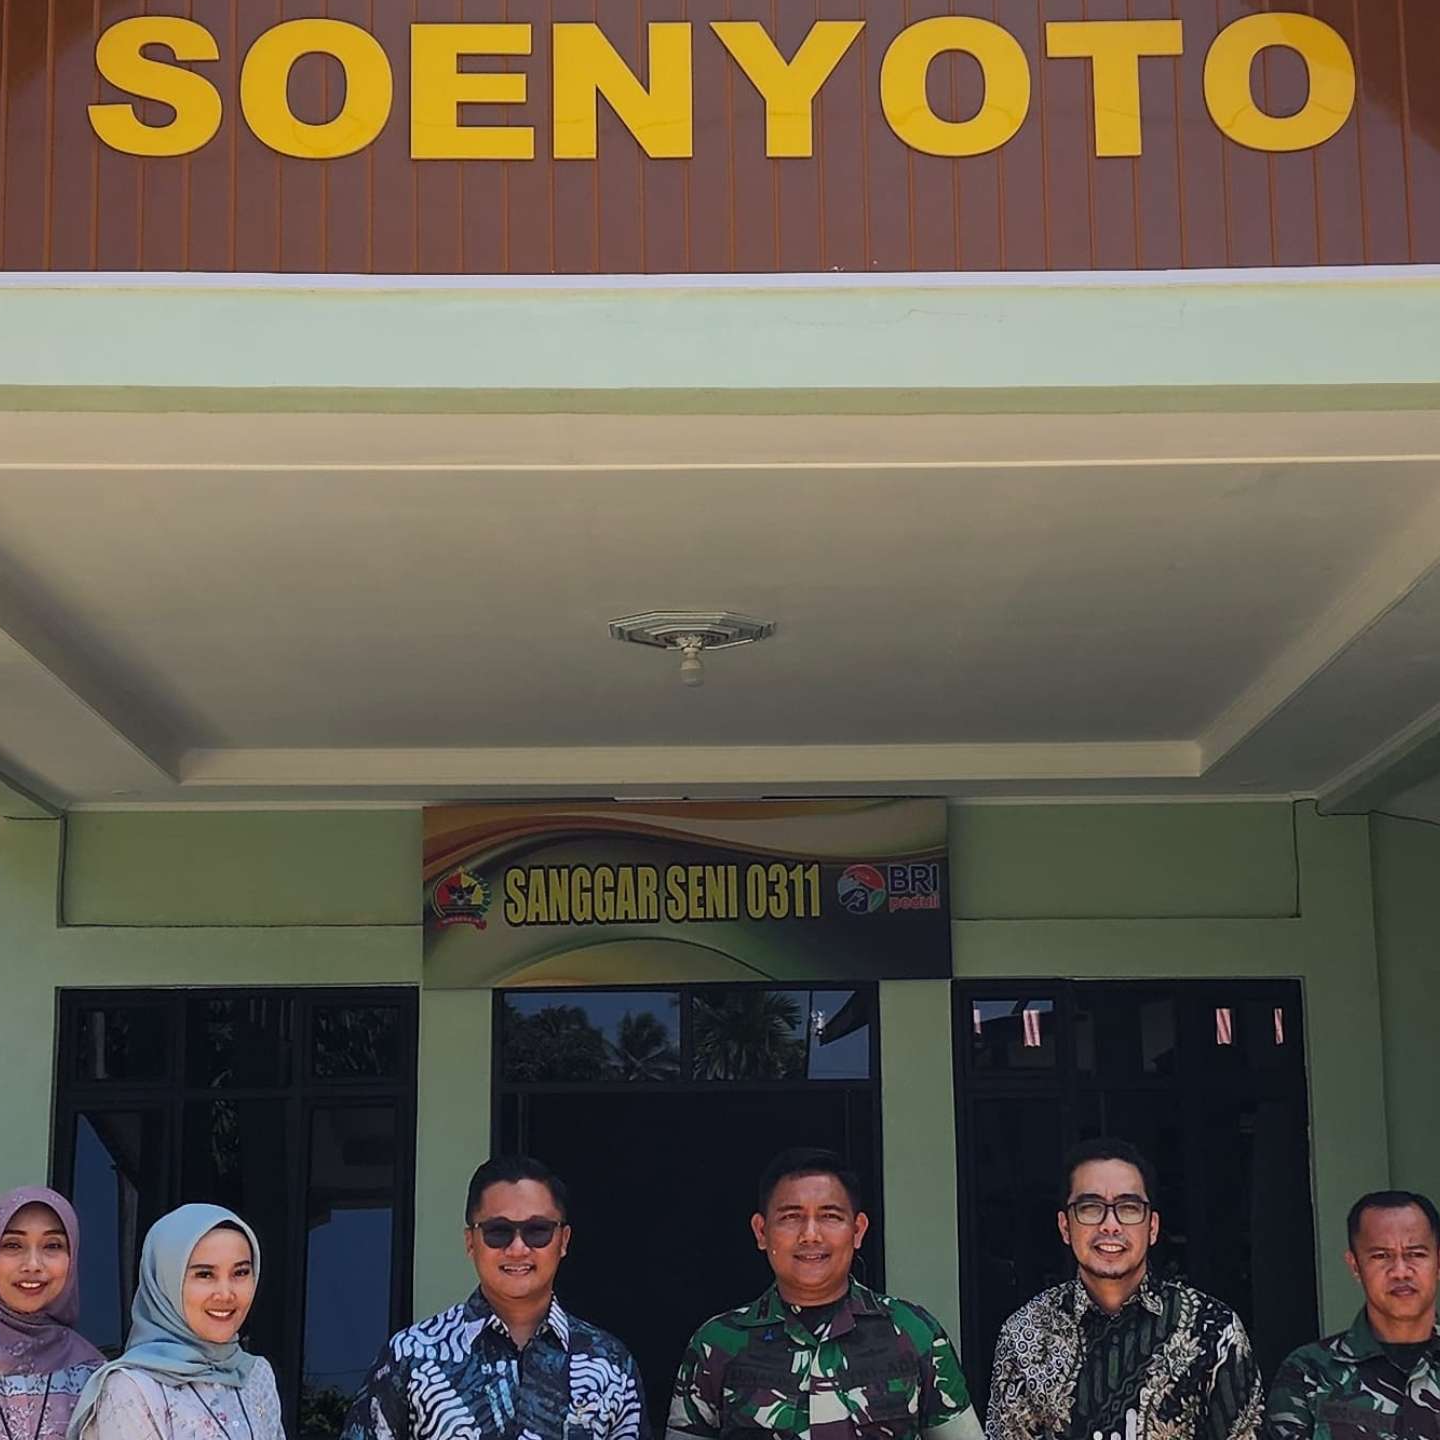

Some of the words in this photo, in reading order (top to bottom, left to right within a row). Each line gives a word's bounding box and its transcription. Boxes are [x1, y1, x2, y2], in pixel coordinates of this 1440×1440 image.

[87, 12, 1356, 160] SOENYOTO
[505, 864, 659, 926] SANGGAR
[666, 863, 738, 922] SENI
[747, 862, 821, 919] 0311
[888, 864, 940, 894] BRI
[889, 894, 941, 912] peduli
